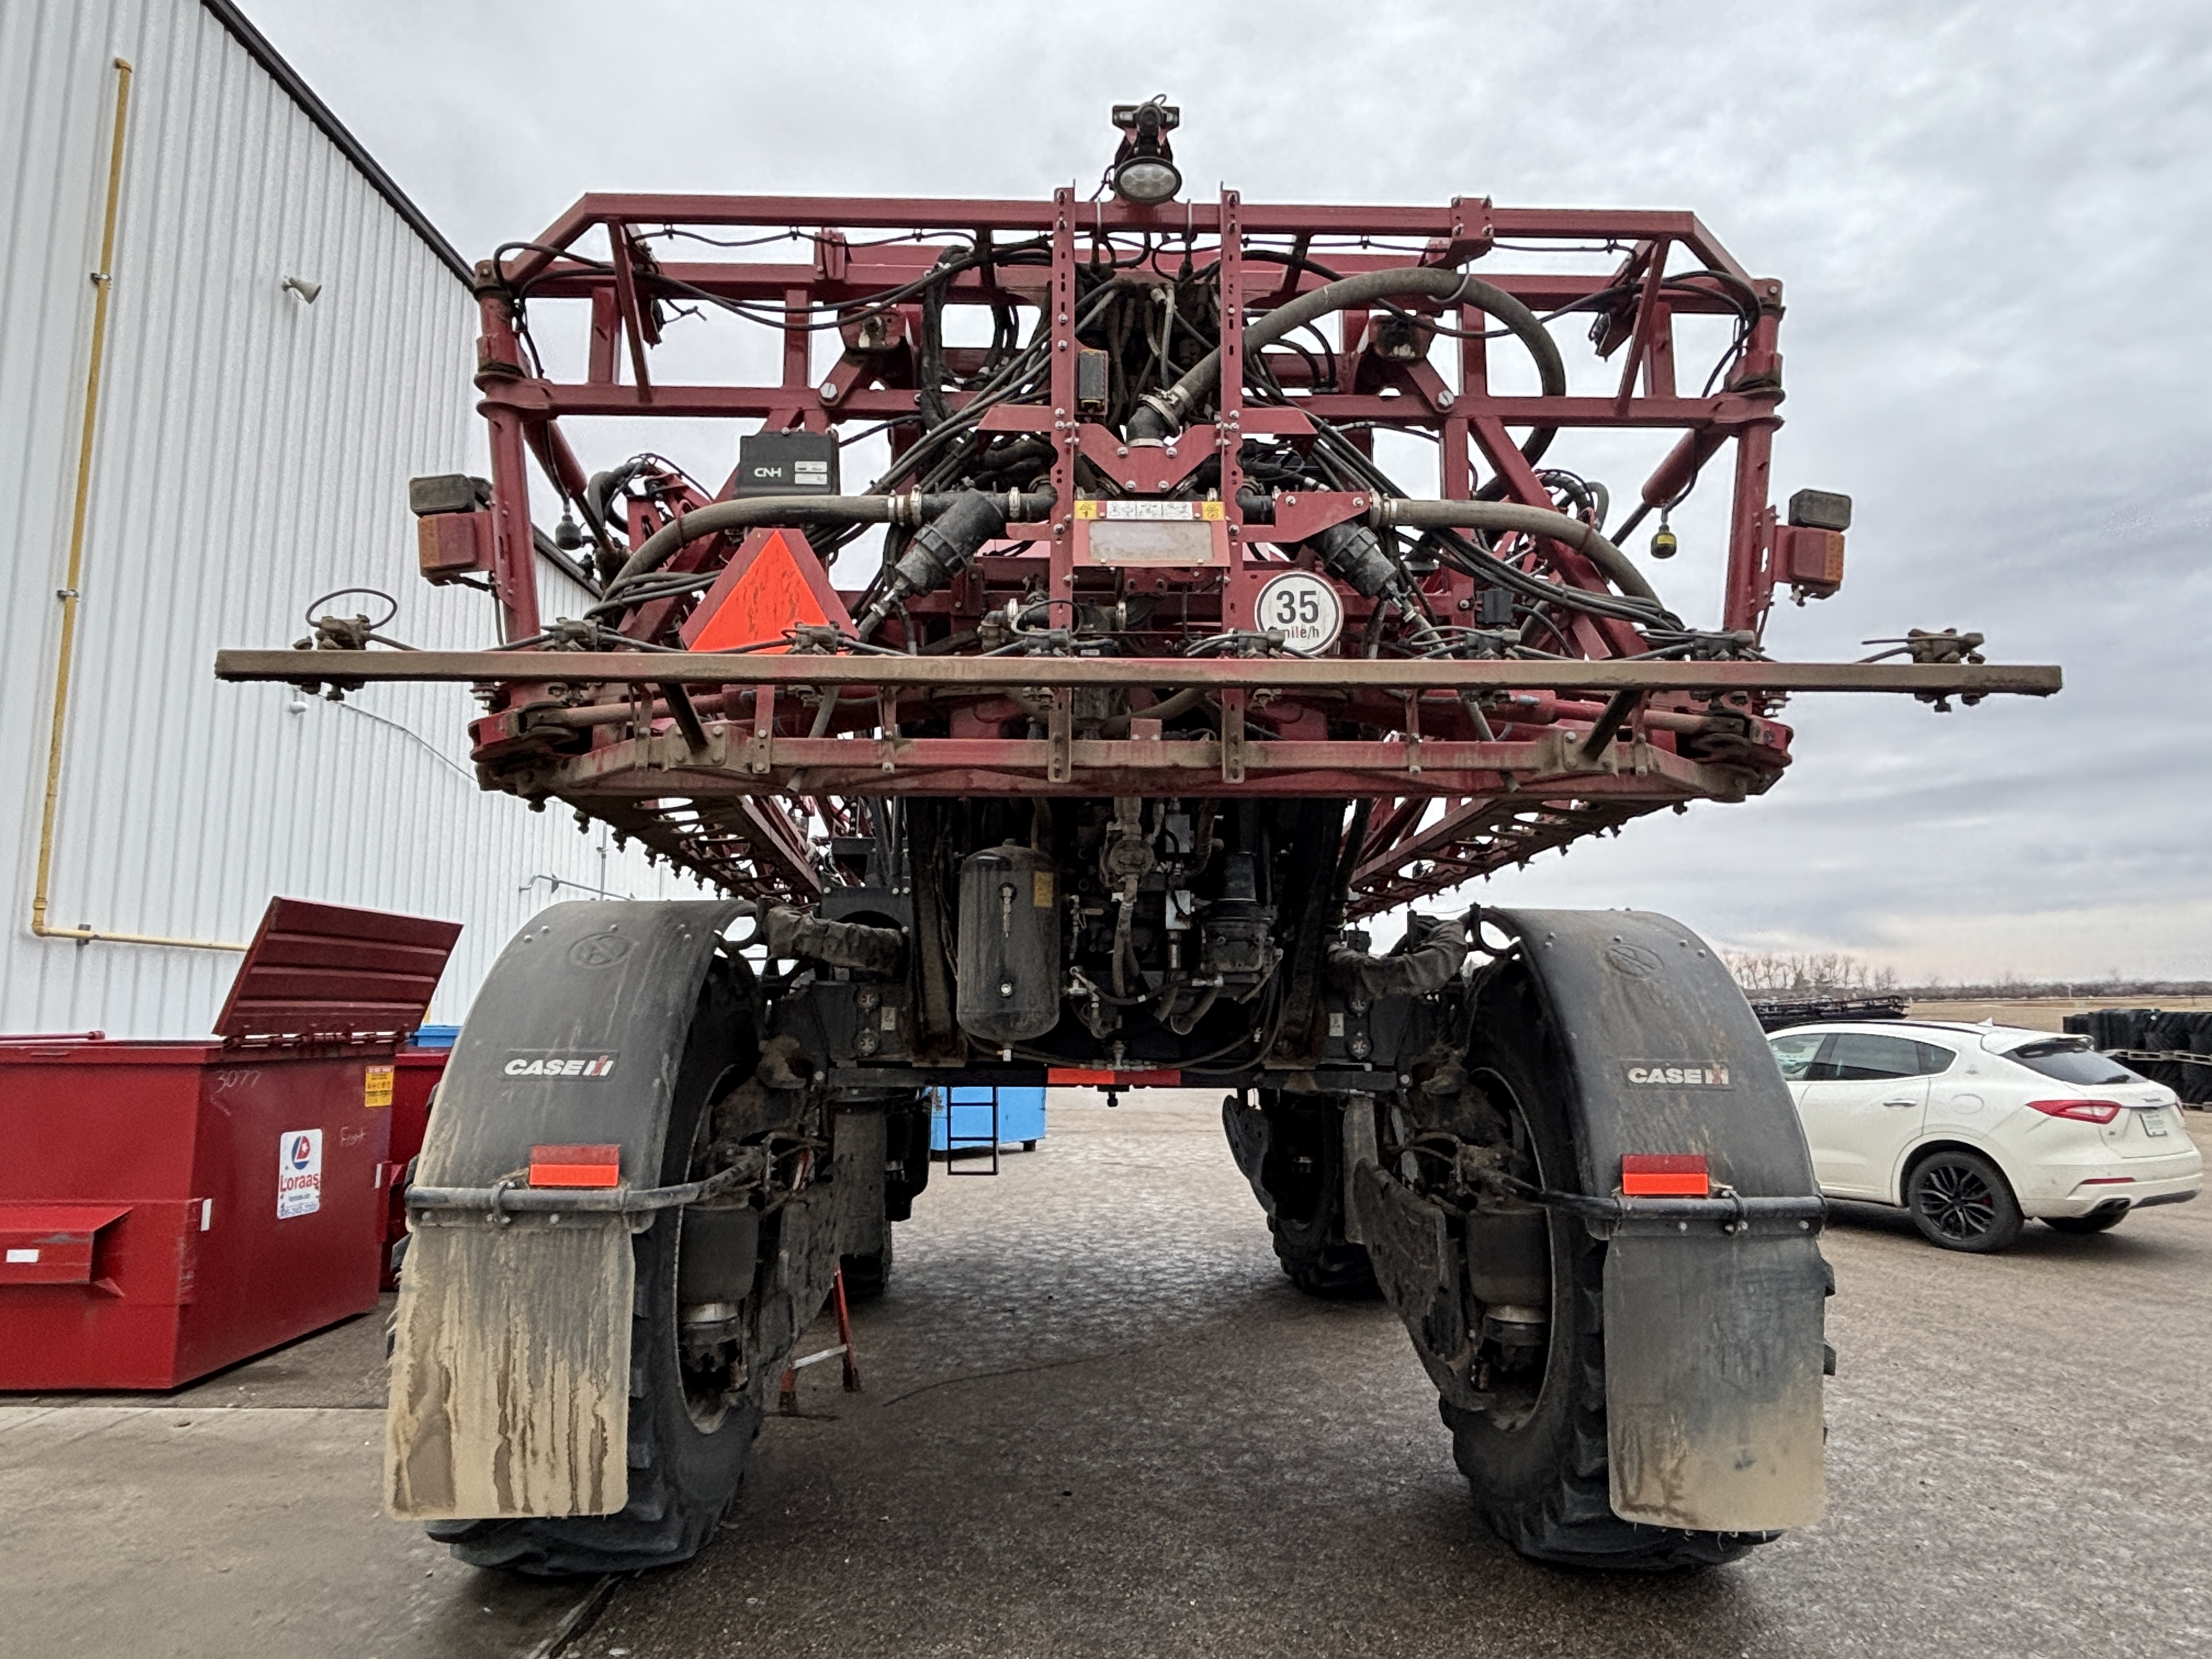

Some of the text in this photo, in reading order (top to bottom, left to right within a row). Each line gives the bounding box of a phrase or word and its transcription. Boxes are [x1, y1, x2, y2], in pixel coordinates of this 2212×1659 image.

[754, 467, 781, 477] CNH
[1276, 590, 1319, 624] 35
[504, 1059, 586, 1075] CASE
[1627, 1068, 1702, 1084] CASE
[280, 1173, 319, 1193] Loraas
